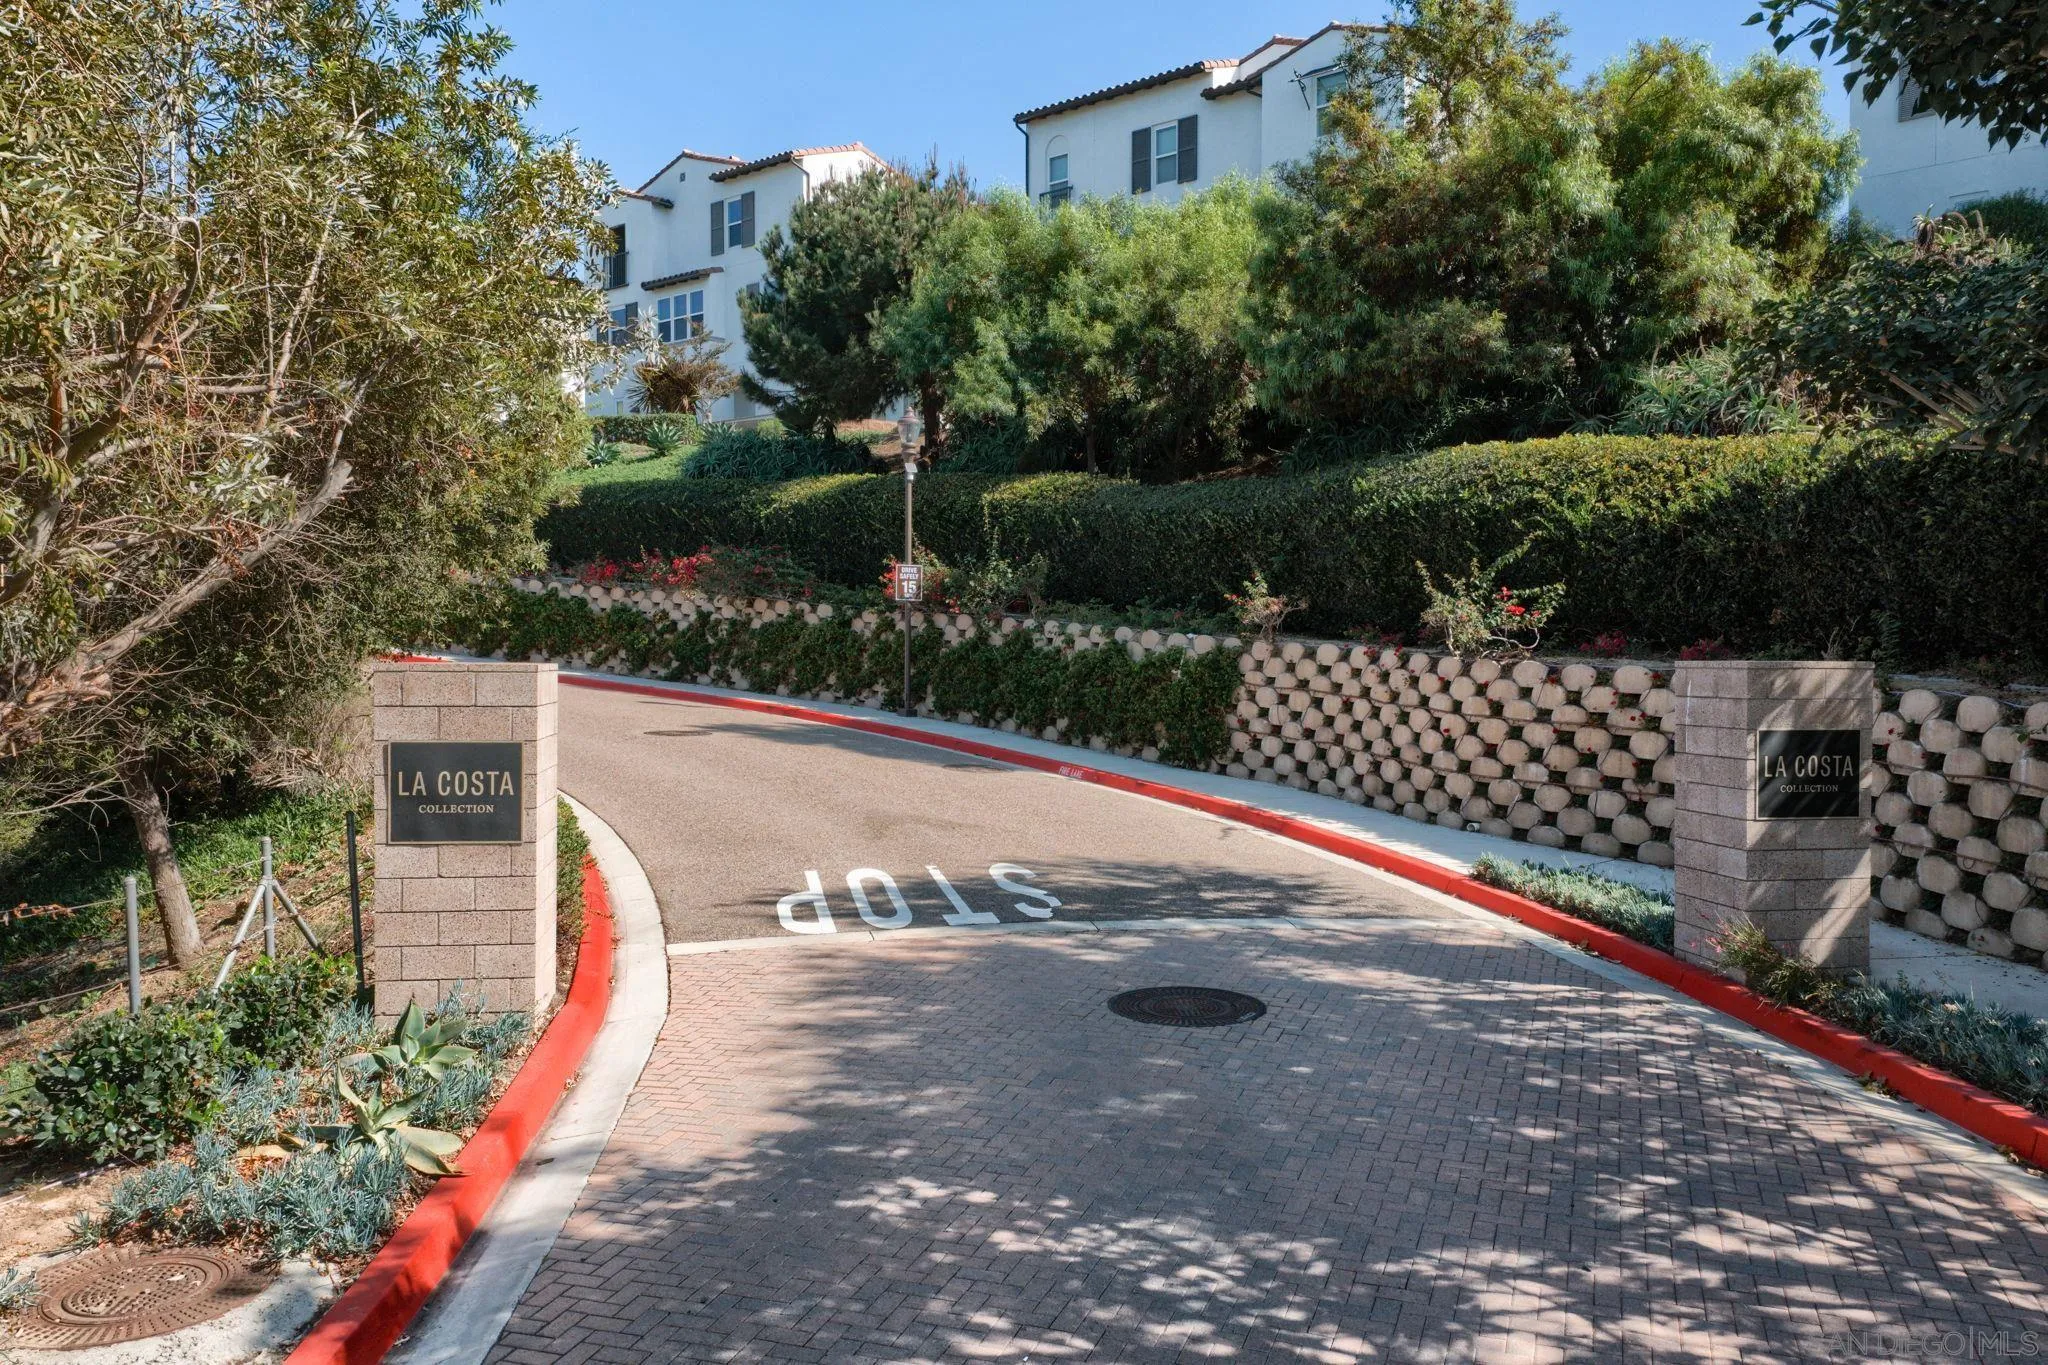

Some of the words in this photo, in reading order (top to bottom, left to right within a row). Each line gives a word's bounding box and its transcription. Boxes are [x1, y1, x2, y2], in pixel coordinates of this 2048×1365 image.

[902, 581, 917, 593] 15
[1764, 755, 1787, 778] LA
[1795, 755, 1854, 778] COSTA
[398, 771, 427, 796] LA
[437, 771, 515, 796] COSTA
[1780, 784, 1839, 793] COLLECTION
[418, 804, 495, 814] COLLECTION
[777, 862, 1063, 935] STOP
